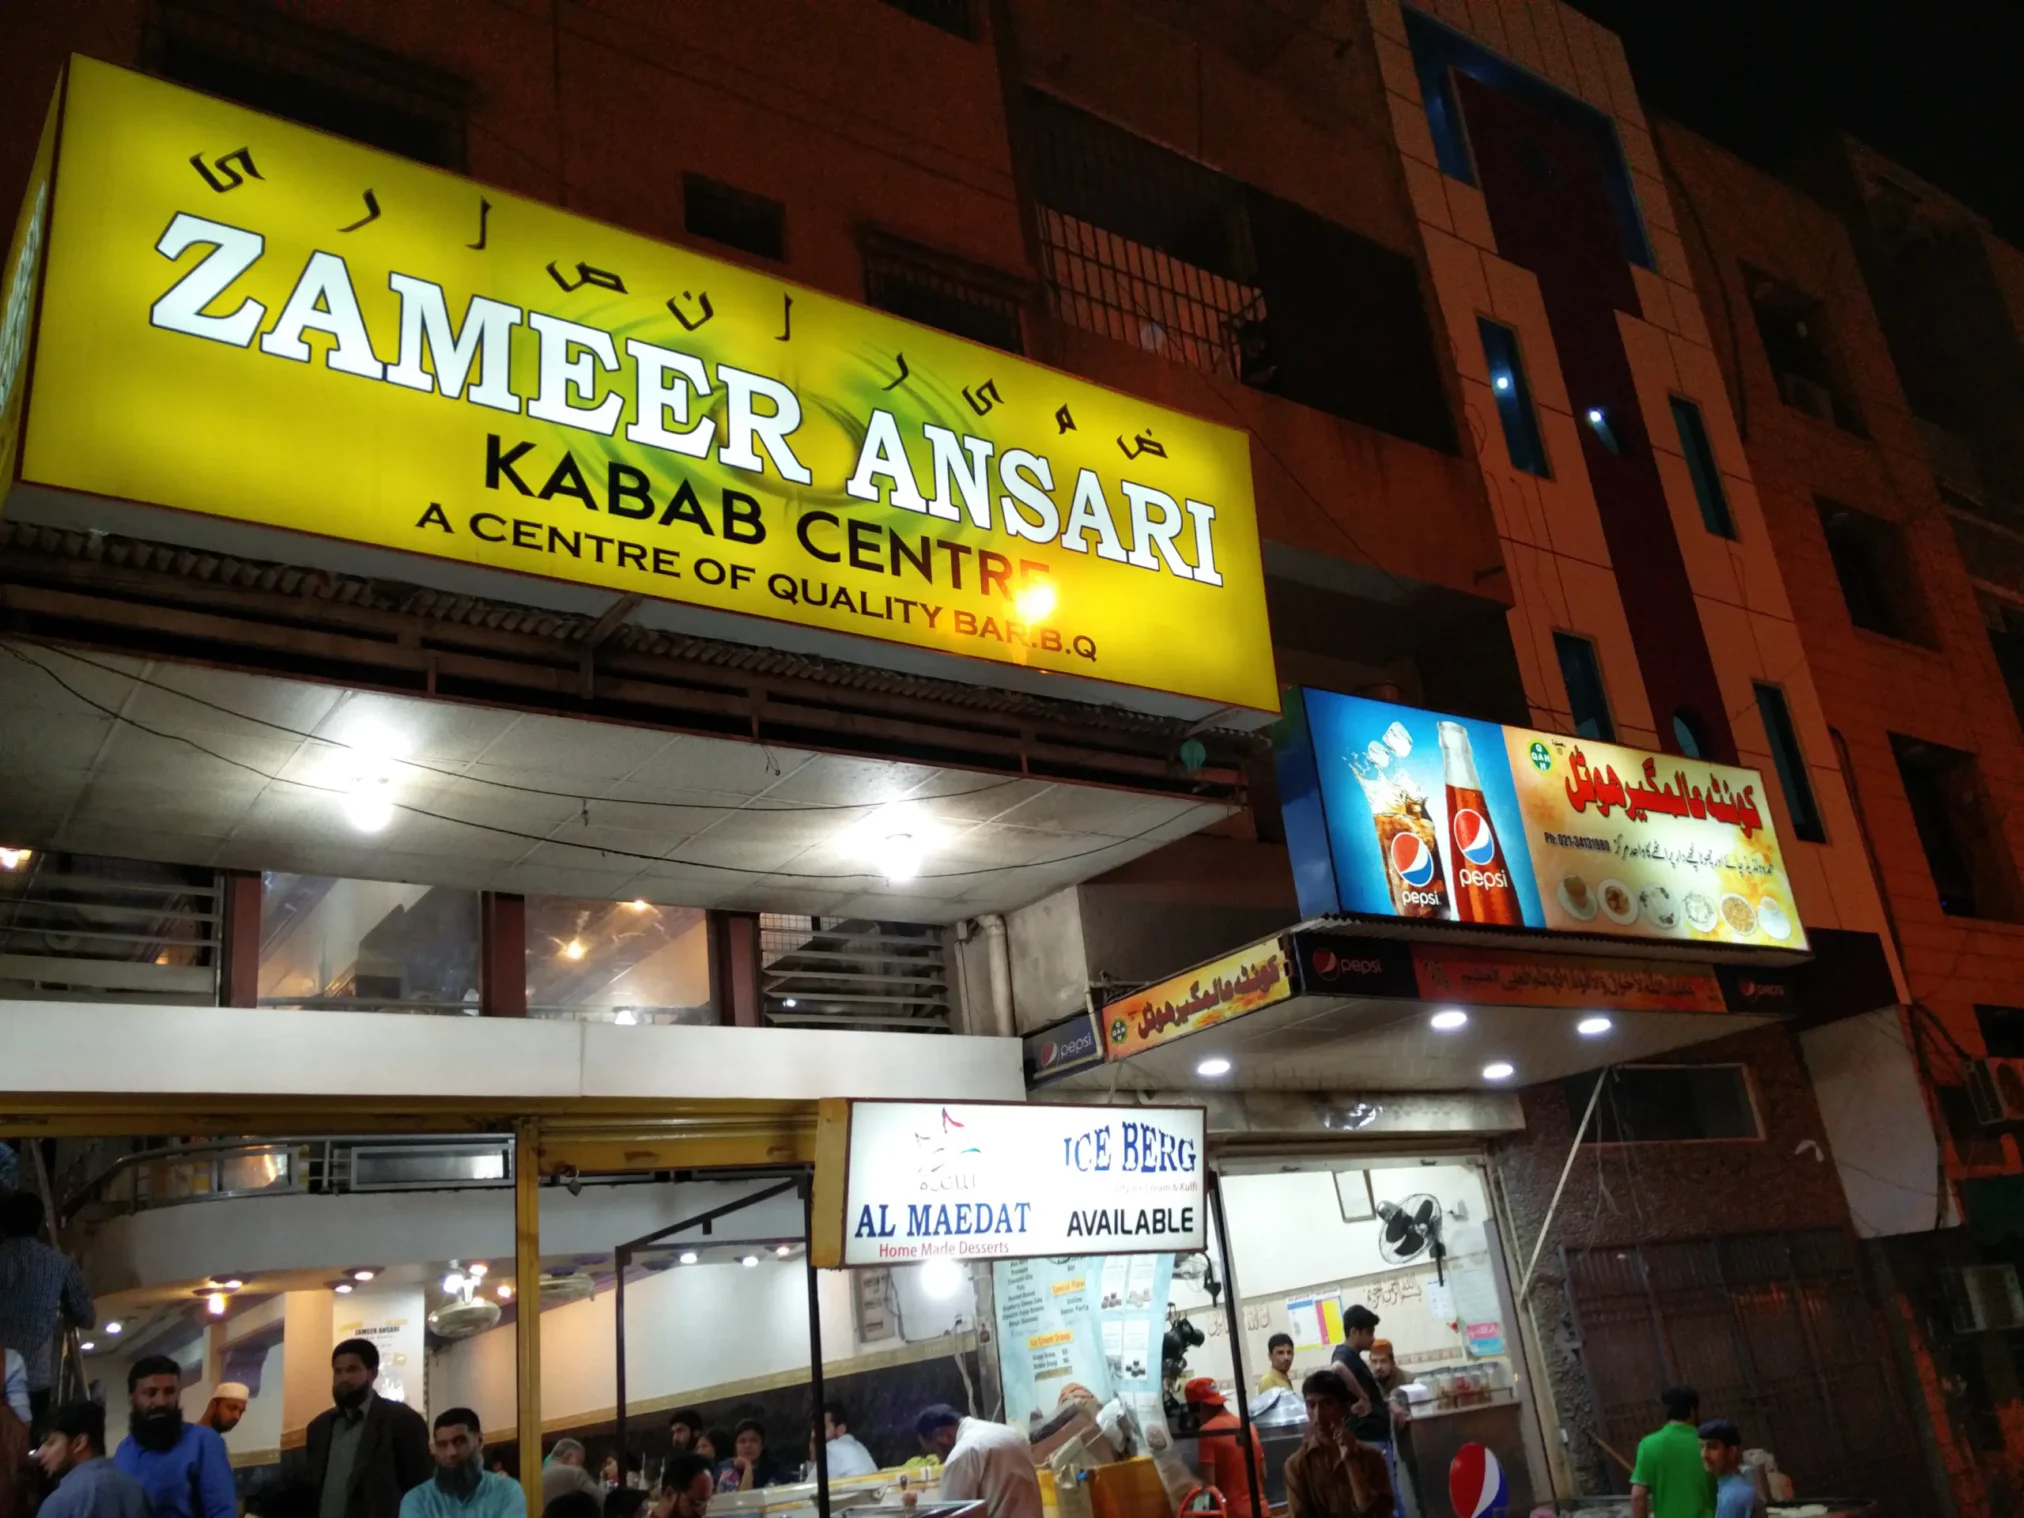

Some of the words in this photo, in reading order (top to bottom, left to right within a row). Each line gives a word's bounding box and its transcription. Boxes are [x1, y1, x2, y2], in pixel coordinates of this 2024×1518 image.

[150, 210, 812, 486] ZAMEER
[846, 408, 1224, 587] ANSARI
[485, 433, 767, 545] KABAB
[415, 502, 455, 535] A
[469, 511, 682, 580] CENTRE
[694, 557, 756, 591] OF
[768, 572, 944, 630] QUALITY
[1460, 868, 1508, 891] pepsi
[1402, 890, 1439, 907] pepsi
[1340, 957, 1382, 975] pepsi
[1060, 1032, 1093, 1059] pepsi
[1064, 1124, 1111, 1172] ICE
[1122, 1121, 1196, 1173] BERG
[854, 1204, 896, 1238] AL
[906, 1202, 1031, 1237] MAEDAT
[1066, 1207, 1194, 1237] AVAILABLE
[879, 1243, 918, 1258] Home
[921, 1242, 956, 1257] Made
[959, 1241, 1010, 1255] Desserts
